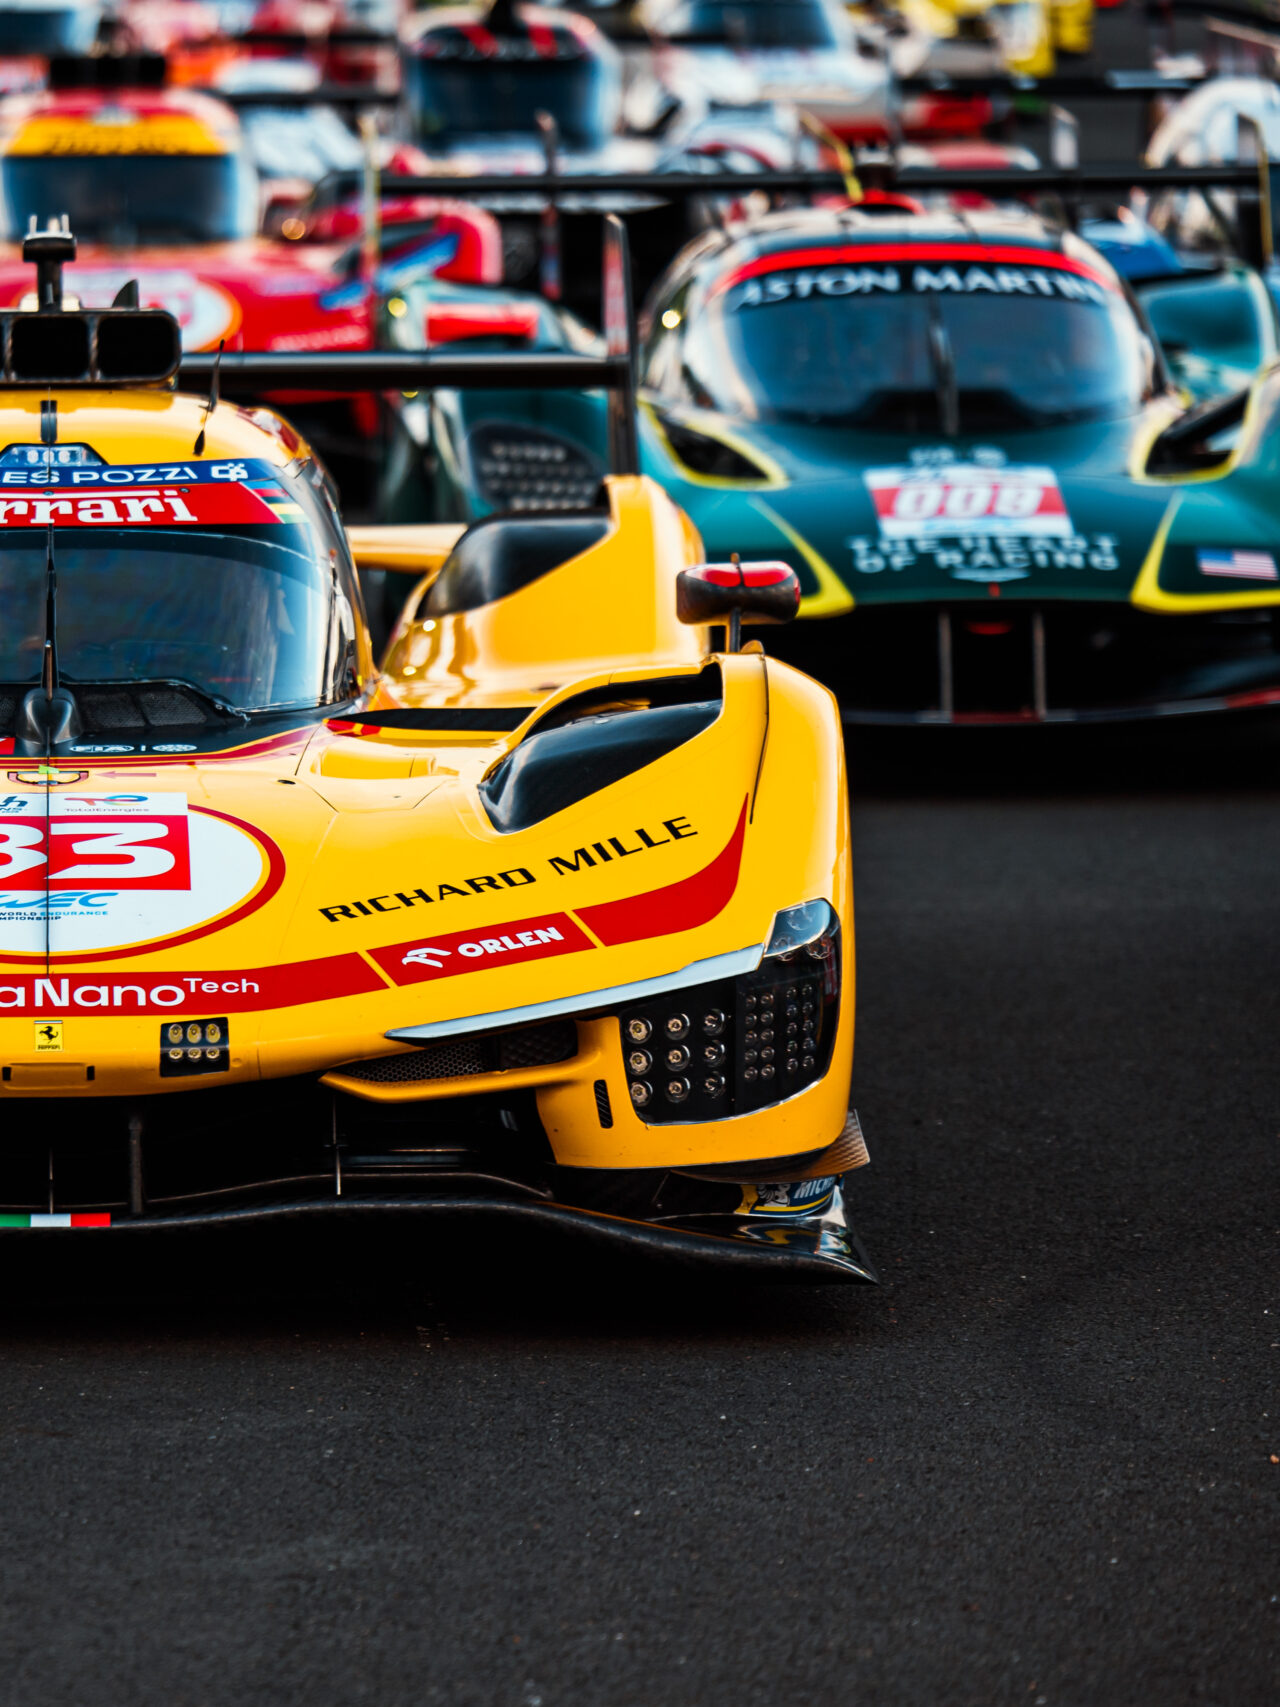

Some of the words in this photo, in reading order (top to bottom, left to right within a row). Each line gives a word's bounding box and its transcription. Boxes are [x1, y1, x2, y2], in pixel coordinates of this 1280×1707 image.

[733, 267, 901, 309] ASTON
[73, 467, 198, 484] POZZI
[853, 552, 916, 573] OF
[933, 549, 1120, 571] RACING
[318, 867, 537, 922] RICHARD
[547, 816, 698, 876] MILLE
[457, 926, 565, 958] ORLEN
